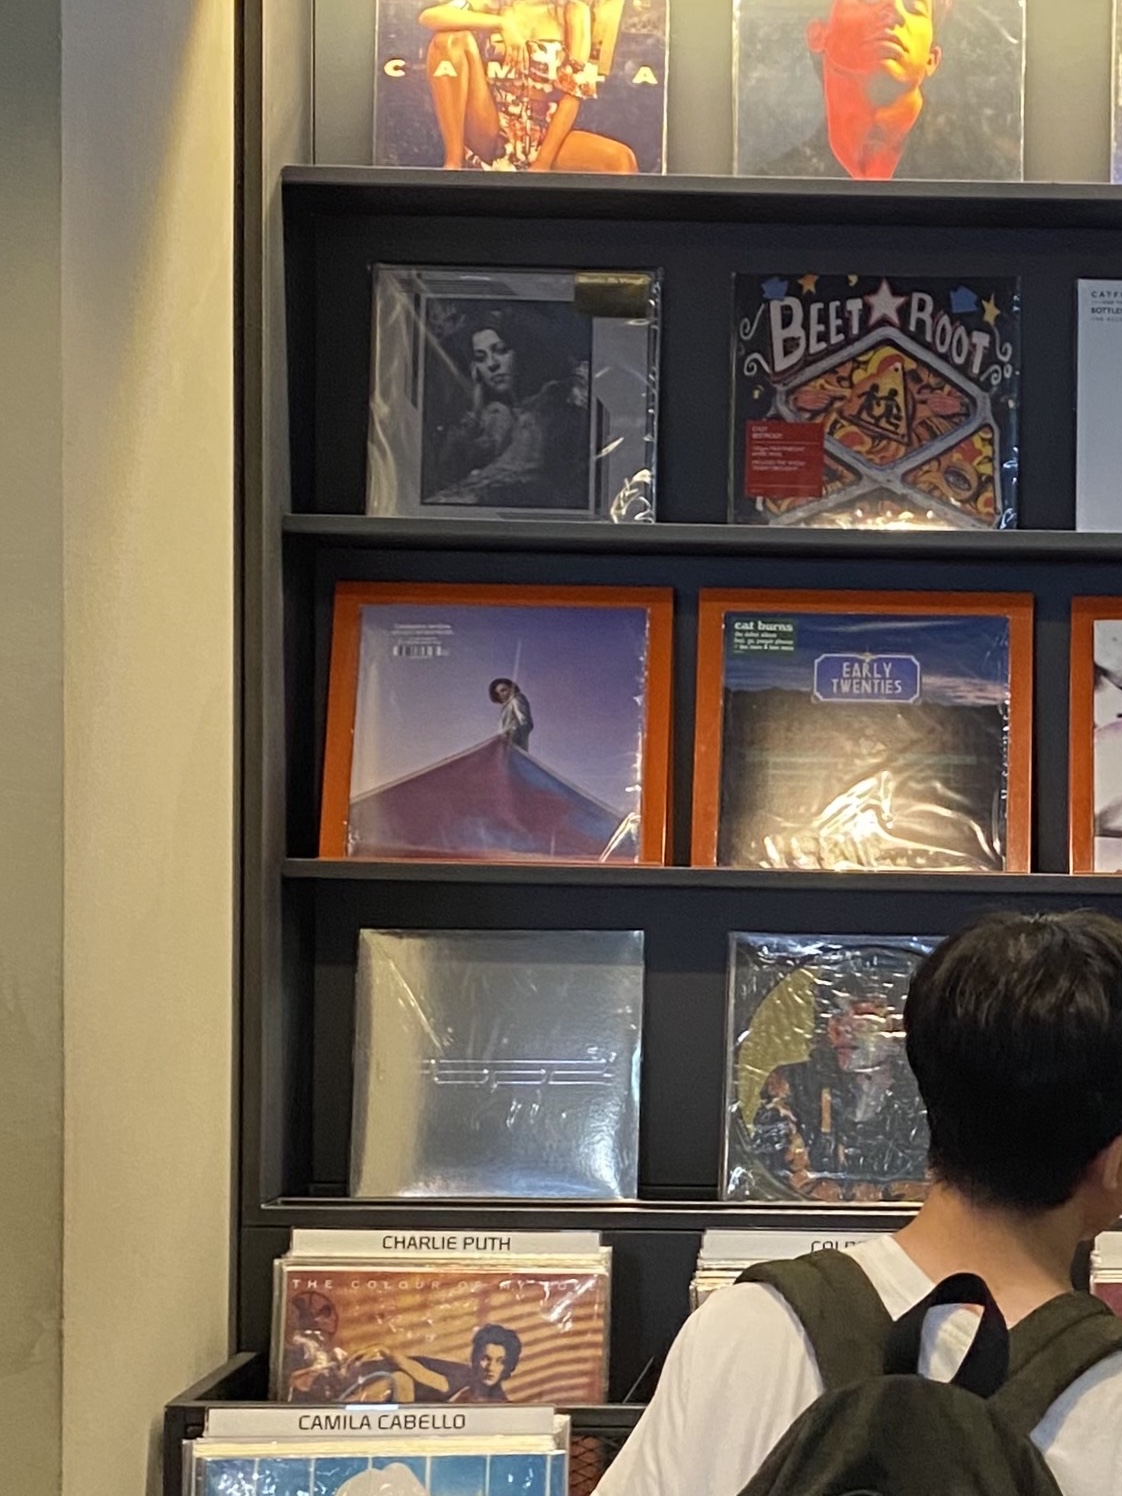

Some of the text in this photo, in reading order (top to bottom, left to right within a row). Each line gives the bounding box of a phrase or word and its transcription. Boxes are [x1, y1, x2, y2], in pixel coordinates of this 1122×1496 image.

[768, 291, 991, 375] BEET ROOT
[842, 662, 893, 679] EARLY
[831, 679, 903, 694] TWENTIES
[382, 1235, 512, 1251] CHARLIE PUTH
[292, 1278, 333, 1289] THE
[351, 1278, 441, 1290] COLOUR
[298, 1414, 466, 1430] CAMILA CABELLO
